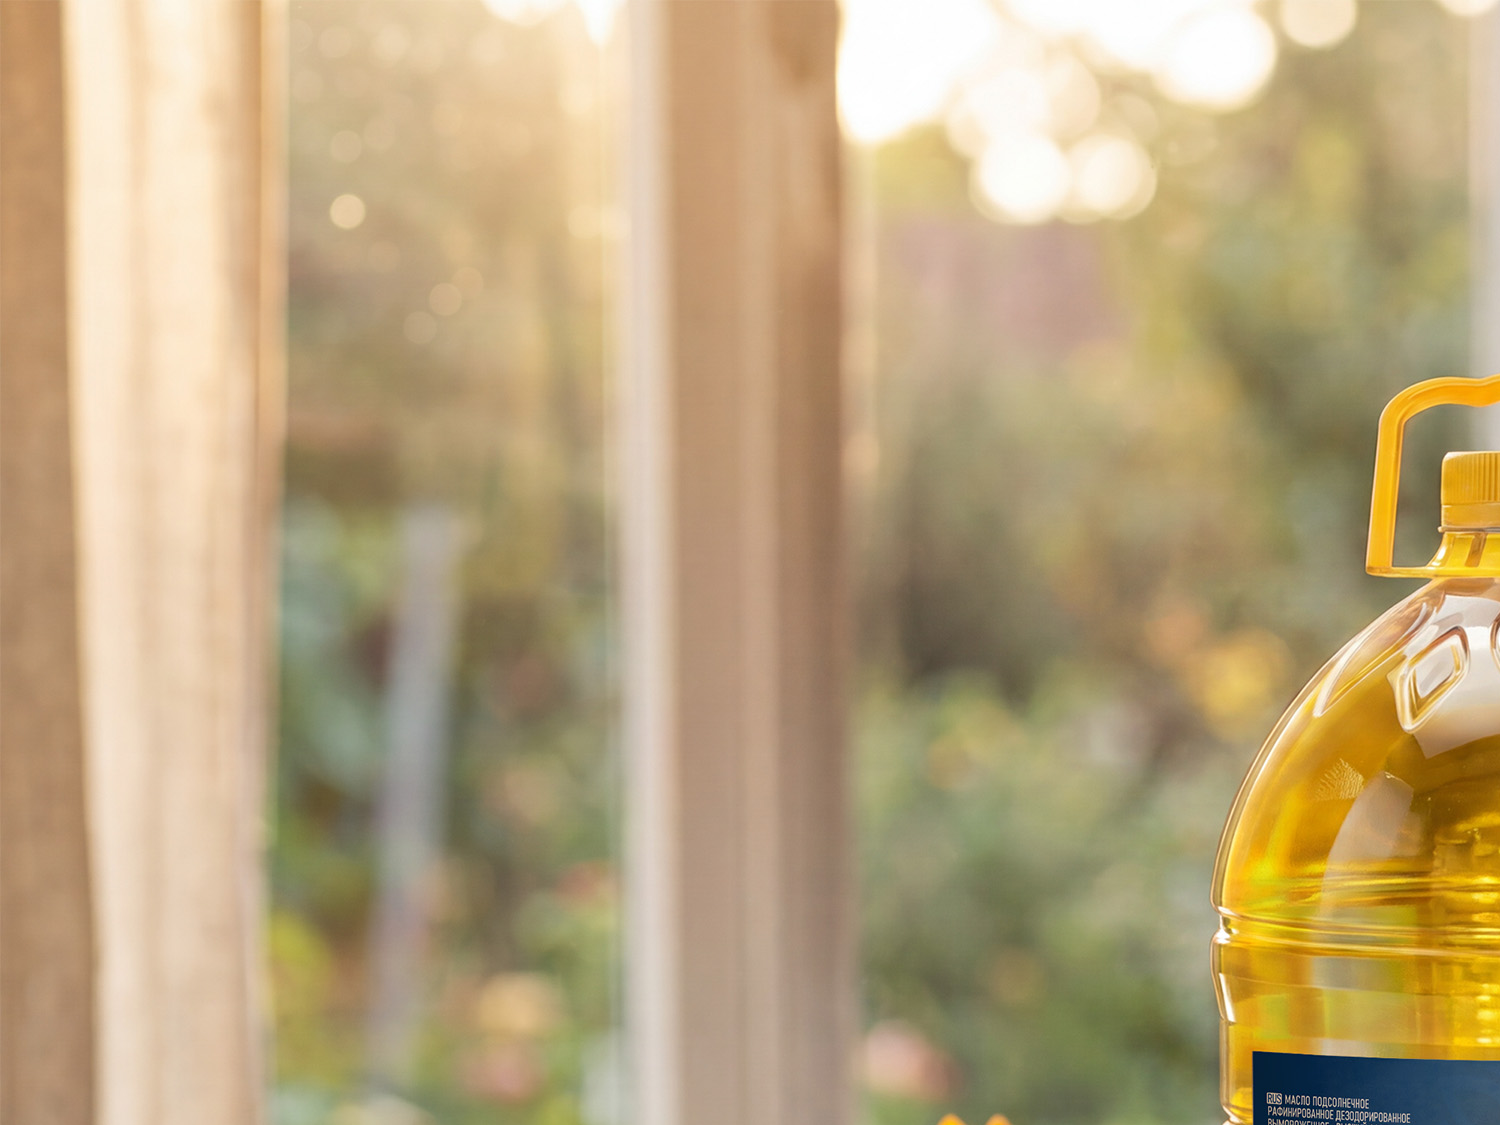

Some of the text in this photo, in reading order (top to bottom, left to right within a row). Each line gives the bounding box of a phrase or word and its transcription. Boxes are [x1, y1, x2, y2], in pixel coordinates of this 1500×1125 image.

[1268, 1094, 1369, 1109] RUS МАСЛО ПОДСОЛНЕЧНОЕ
[1268, 1106, 1410, 1123] РАФИНИРОВАННОЕ ДЕЗОДОРИРОВАННОЕ
